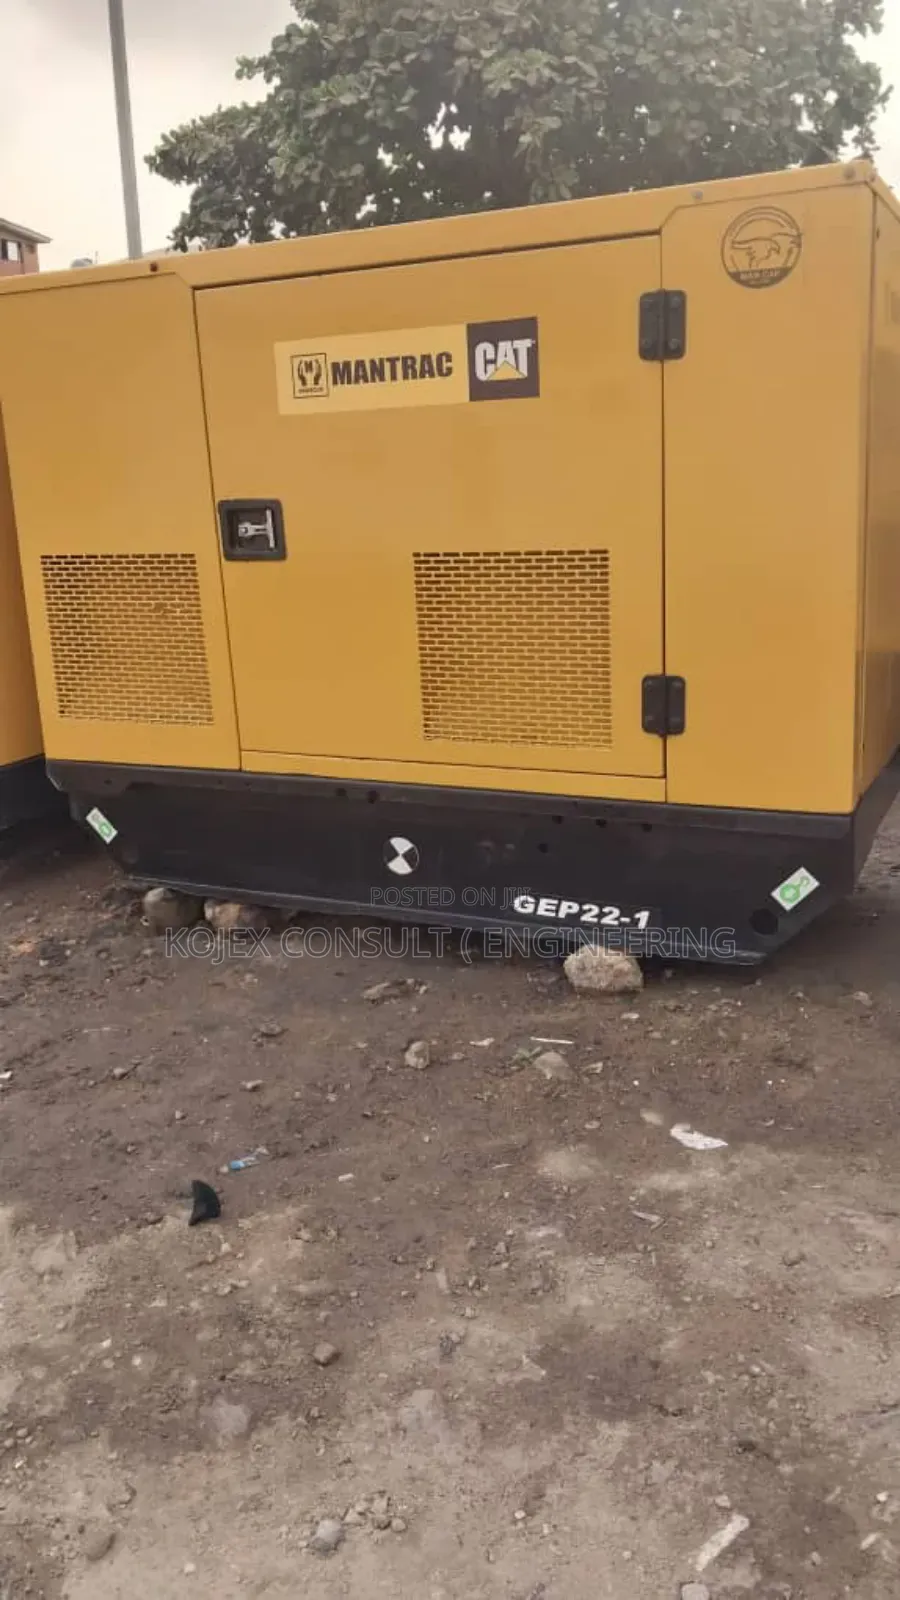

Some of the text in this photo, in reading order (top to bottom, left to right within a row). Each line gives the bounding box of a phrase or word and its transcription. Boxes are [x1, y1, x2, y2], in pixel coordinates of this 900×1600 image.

[330, 351, 453, 386] MANTRAC
[475, 339, 532, 381] CAT
[513, 895, 650, 930] GEP22-1
